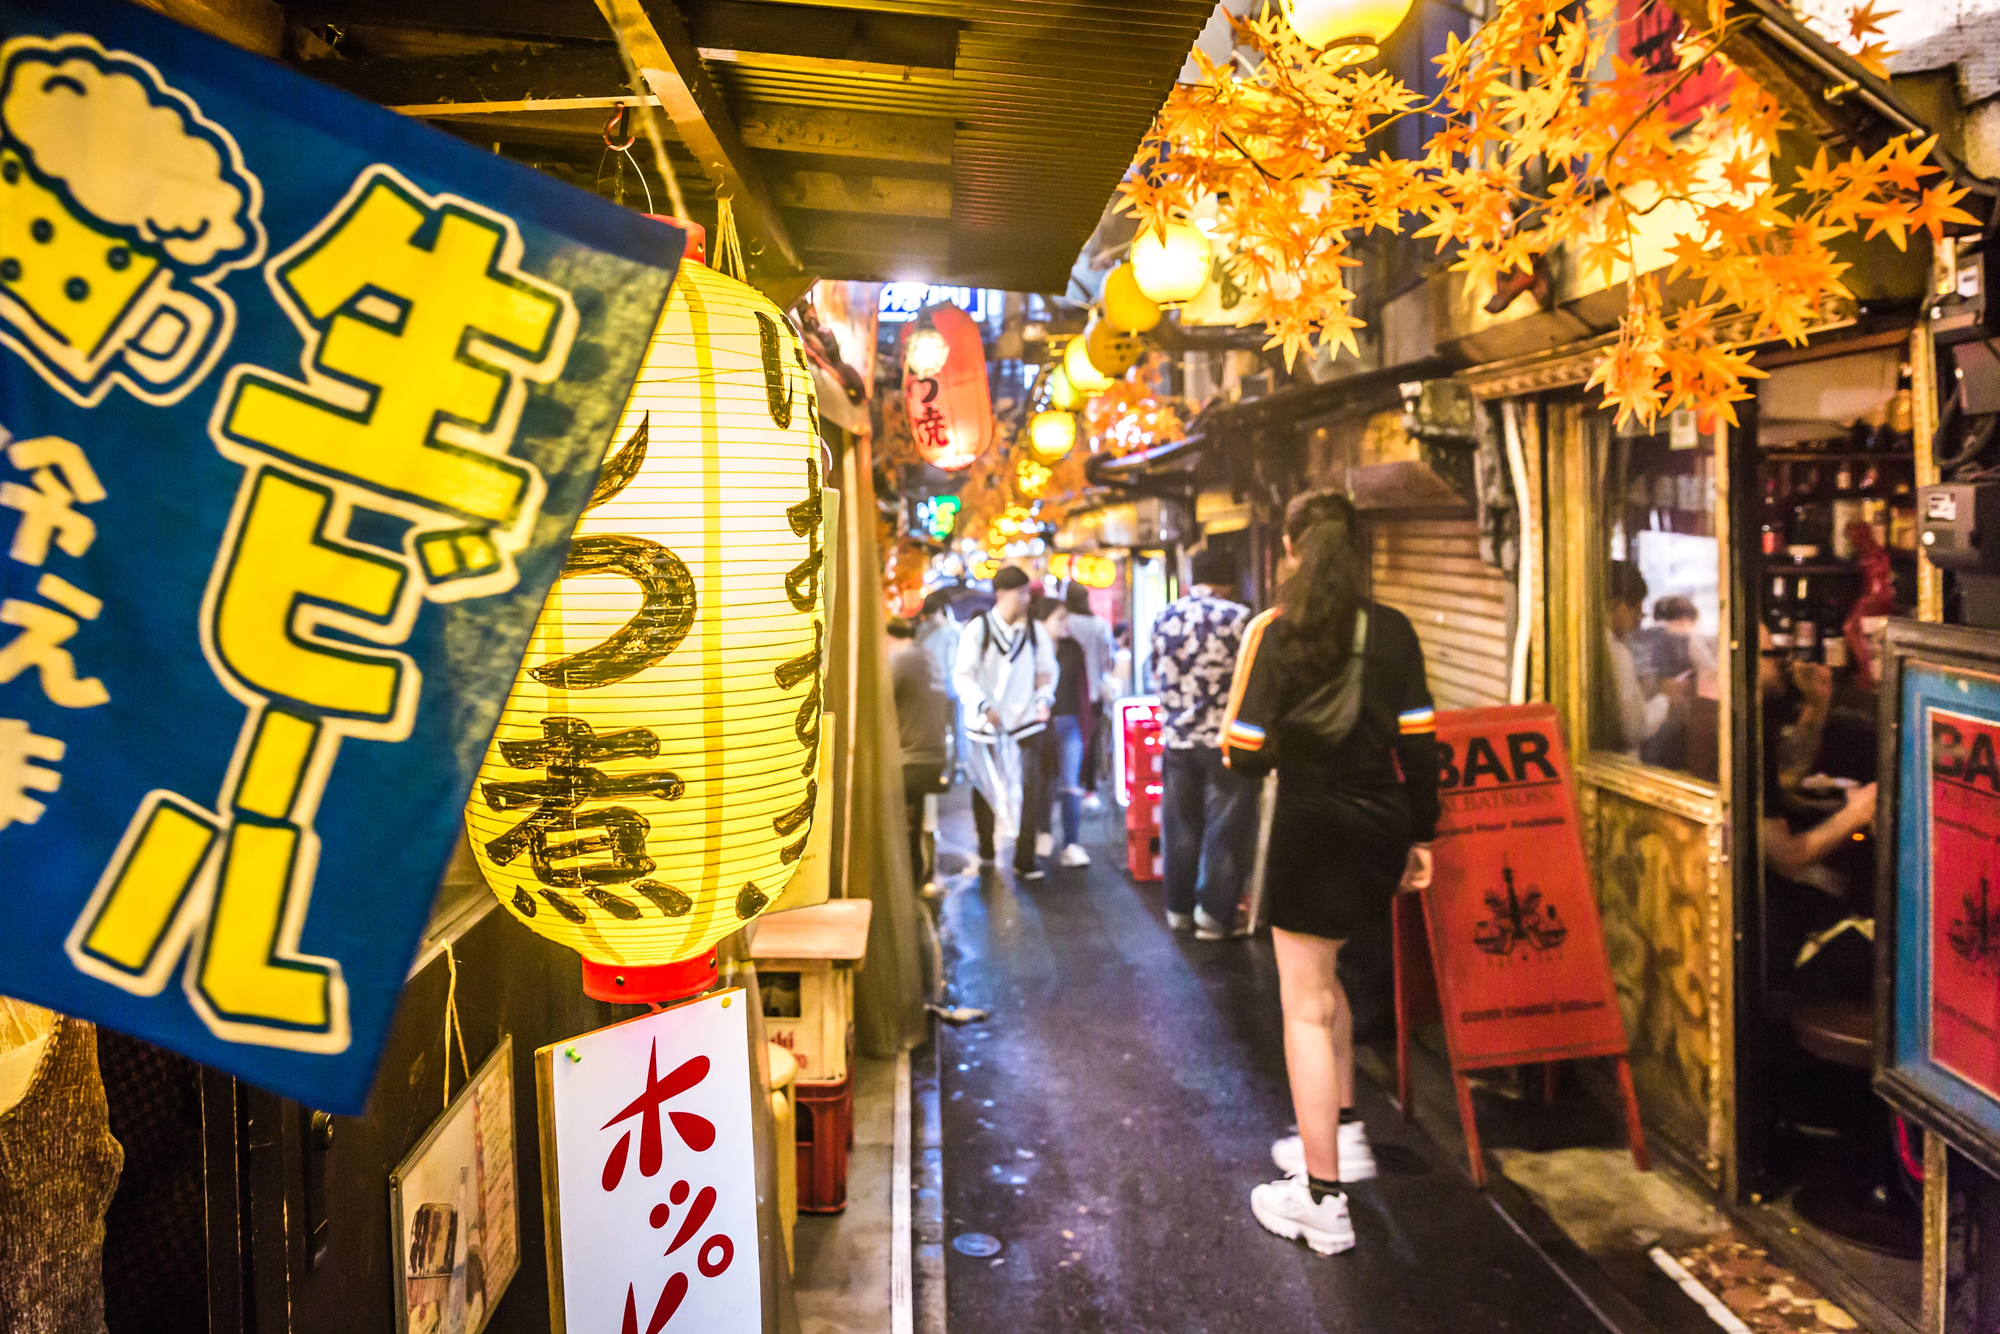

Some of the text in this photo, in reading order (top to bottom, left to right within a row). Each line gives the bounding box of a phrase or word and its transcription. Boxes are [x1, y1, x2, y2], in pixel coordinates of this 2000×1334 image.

[909, 374, 950, 446] つ焼
[67, 162, 578, 1053] 生ビール
[1436, 732, 1558, 787] BAR
